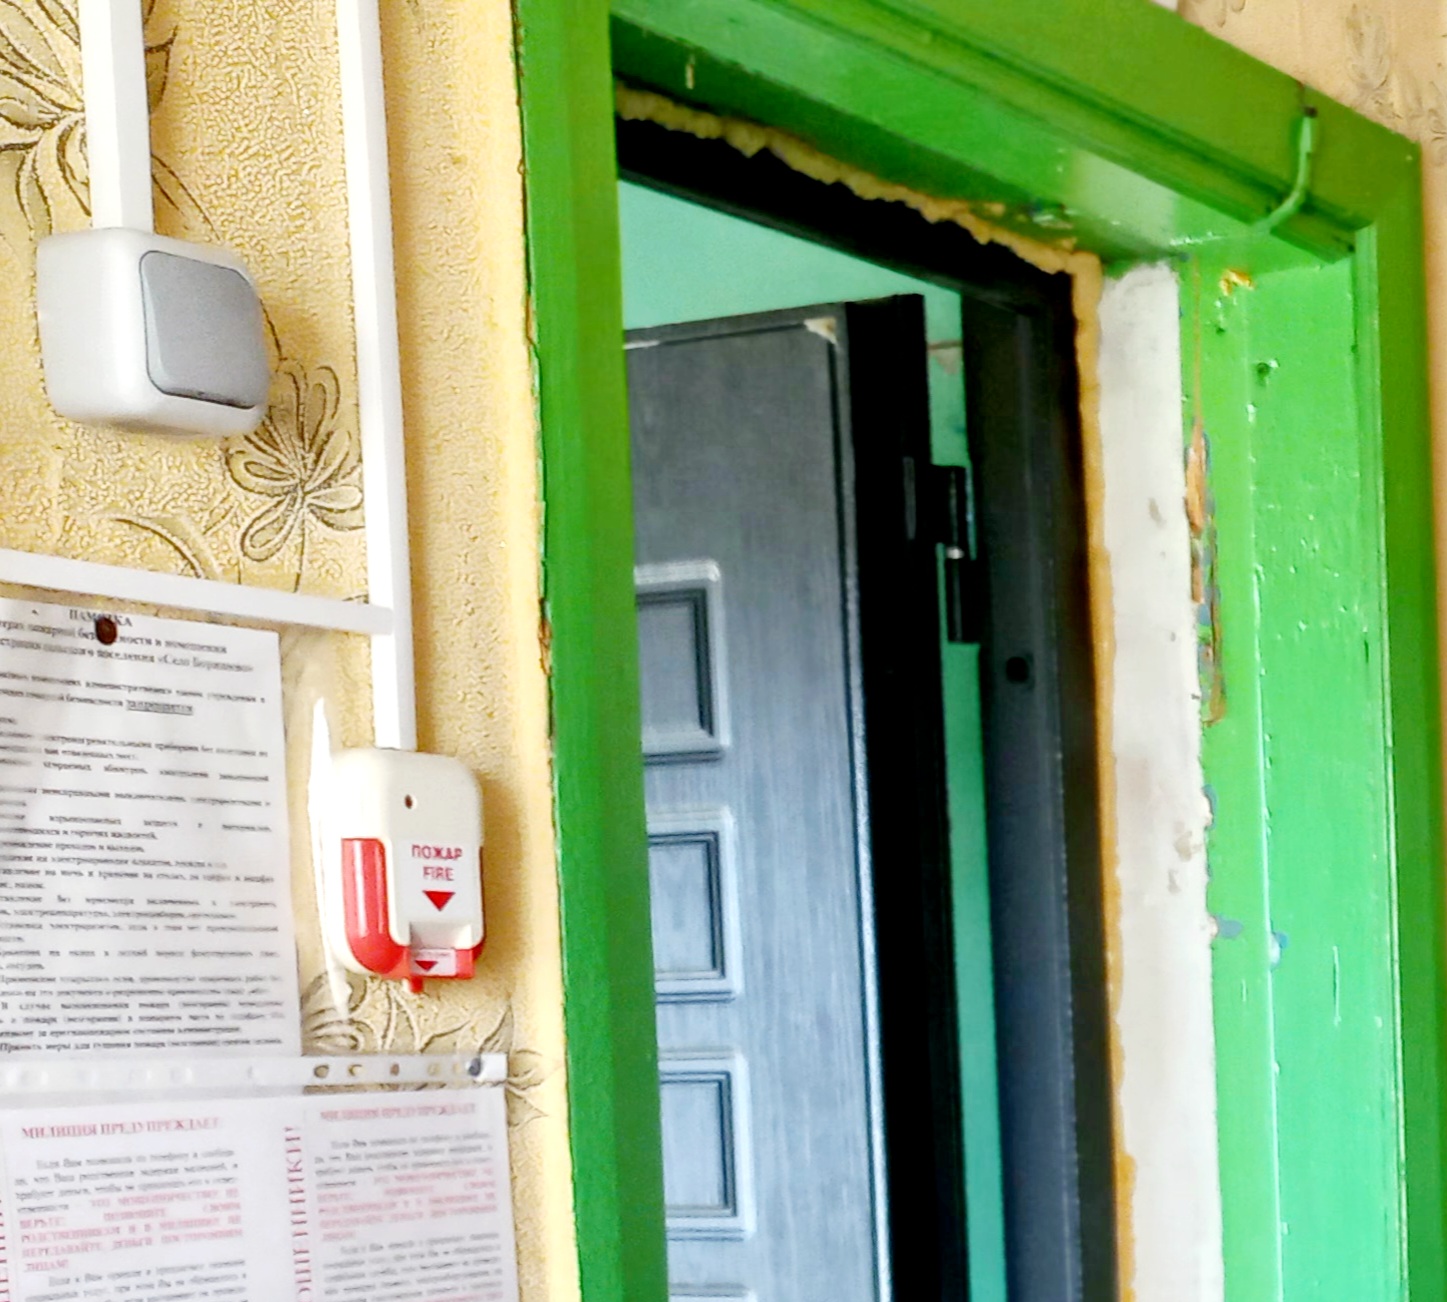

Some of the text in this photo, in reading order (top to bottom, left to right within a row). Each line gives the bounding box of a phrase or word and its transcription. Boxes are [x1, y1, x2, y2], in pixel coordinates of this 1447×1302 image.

[69, 608, 133, 627] ПАМТКА
[411, 843, 463, 860] ПОЖАР
[423, 866, 454, 882] FIRE
